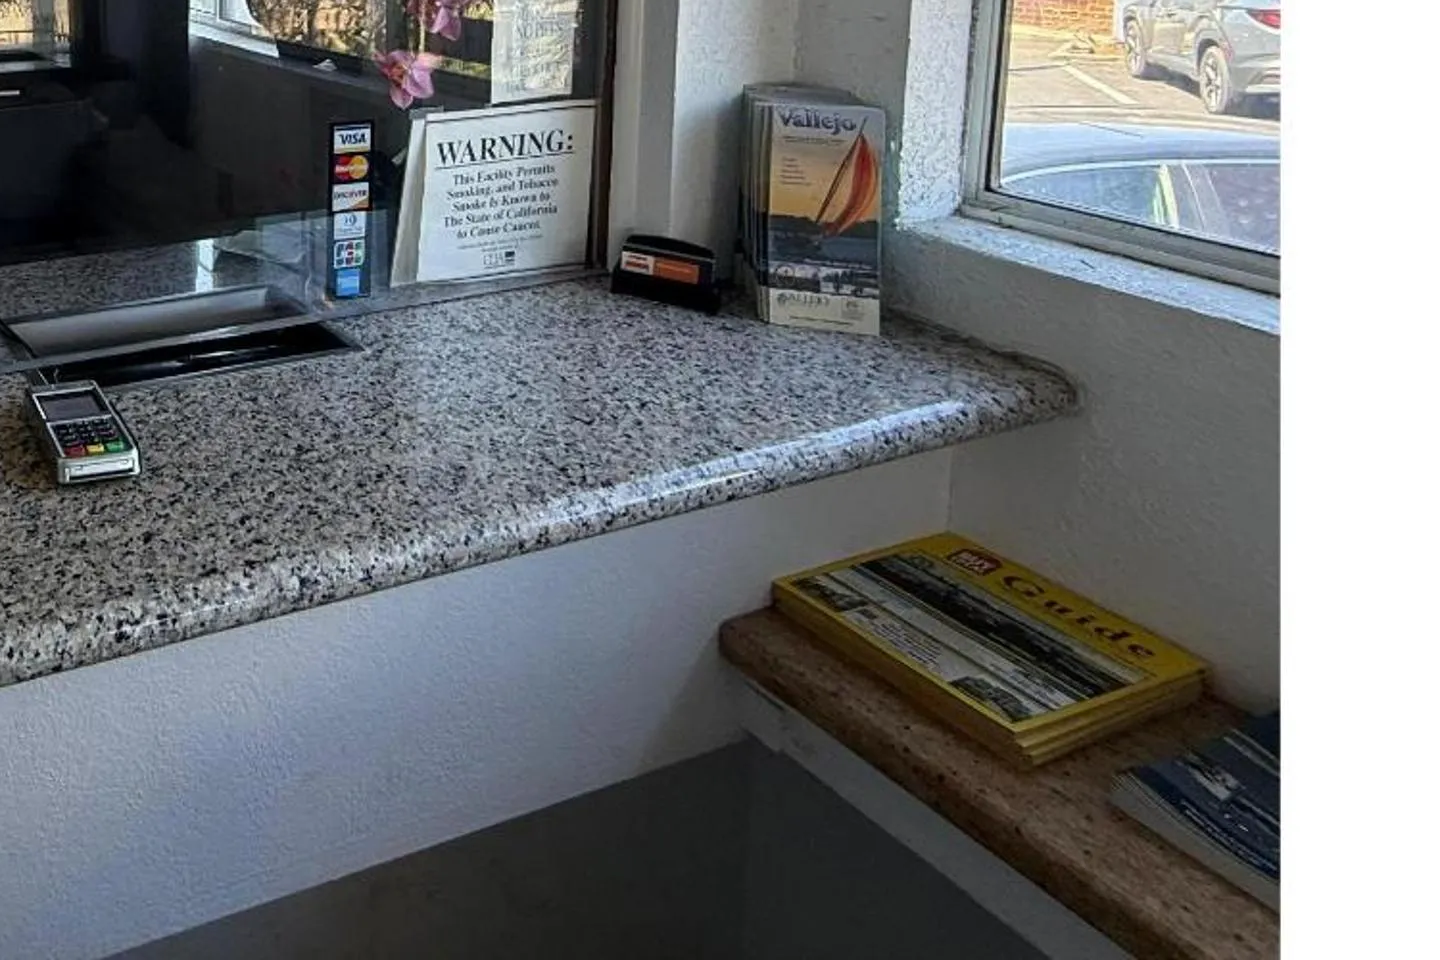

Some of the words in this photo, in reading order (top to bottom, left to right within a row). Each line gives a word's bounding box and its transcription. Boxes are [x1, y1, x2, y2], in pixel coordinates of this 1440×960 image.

[777, 107, 856, 135] Vallejo
[338, 133, 367, 146] VISA
[437, 129, 573, 165] WARNING:
[453, 173, 475, 186] This
[477, 168, 513, 183] Facility
[517, 164, 555, 177] Permits
[496, 181, 515, 193] and
[519, 178, 558, 190] Tobacco
[452, 199, 487, 212] Smoke
[501, 193, 537, 206] Known
[444, 216, 464, 228] The
[465, 213, 490, 224] State
[493, 209, 505, 220] of
[506, 202, 558, 219] California
[470, 224, 501, 237] Cause
[1003, 575, 1157, 657] Guide
